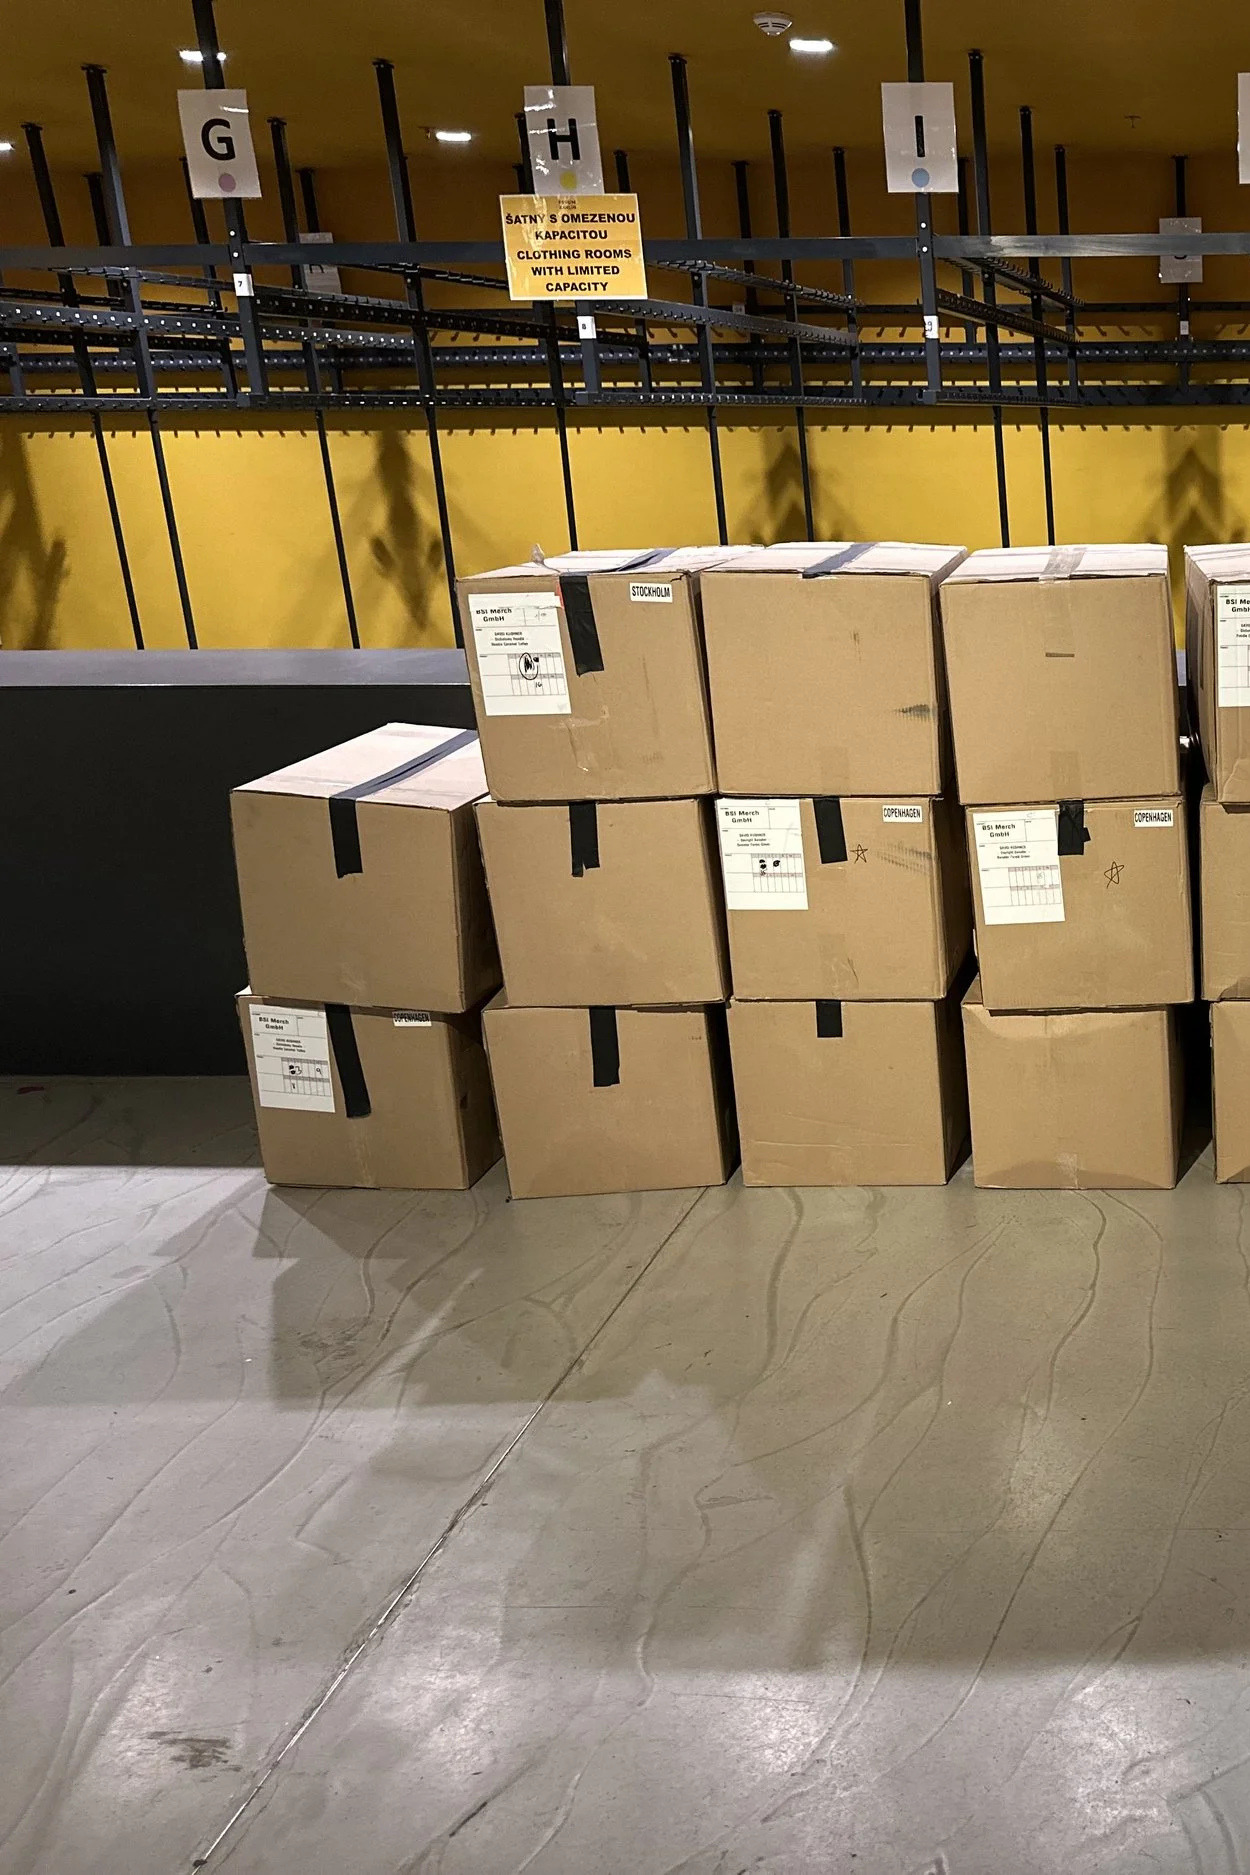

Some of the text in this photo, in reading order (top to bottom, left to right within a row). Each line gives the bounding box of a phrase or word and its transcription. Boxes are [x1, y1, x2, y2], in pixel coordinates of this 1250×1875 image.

[201, 118, 236, 160] G
[547, 119, 580, 160] H
[915, 115, 925, 157] I
[506, 213, 635, 224] ŠATNY S OMEZENOU
[535, 230, 608, 240] KAPACITOU
[517, 249, 632, 260] CLOTHING ROOMS
[531, 266, 620, 276] WITH LIMITED
[545, 282, 609, 292] CAPACITY
[632, 586, 671, 598] STOCKHOLM
[883, 808, 921, 818] COPENHAGEN
[1134, 812, 1172, 823] COPENHAGEN
